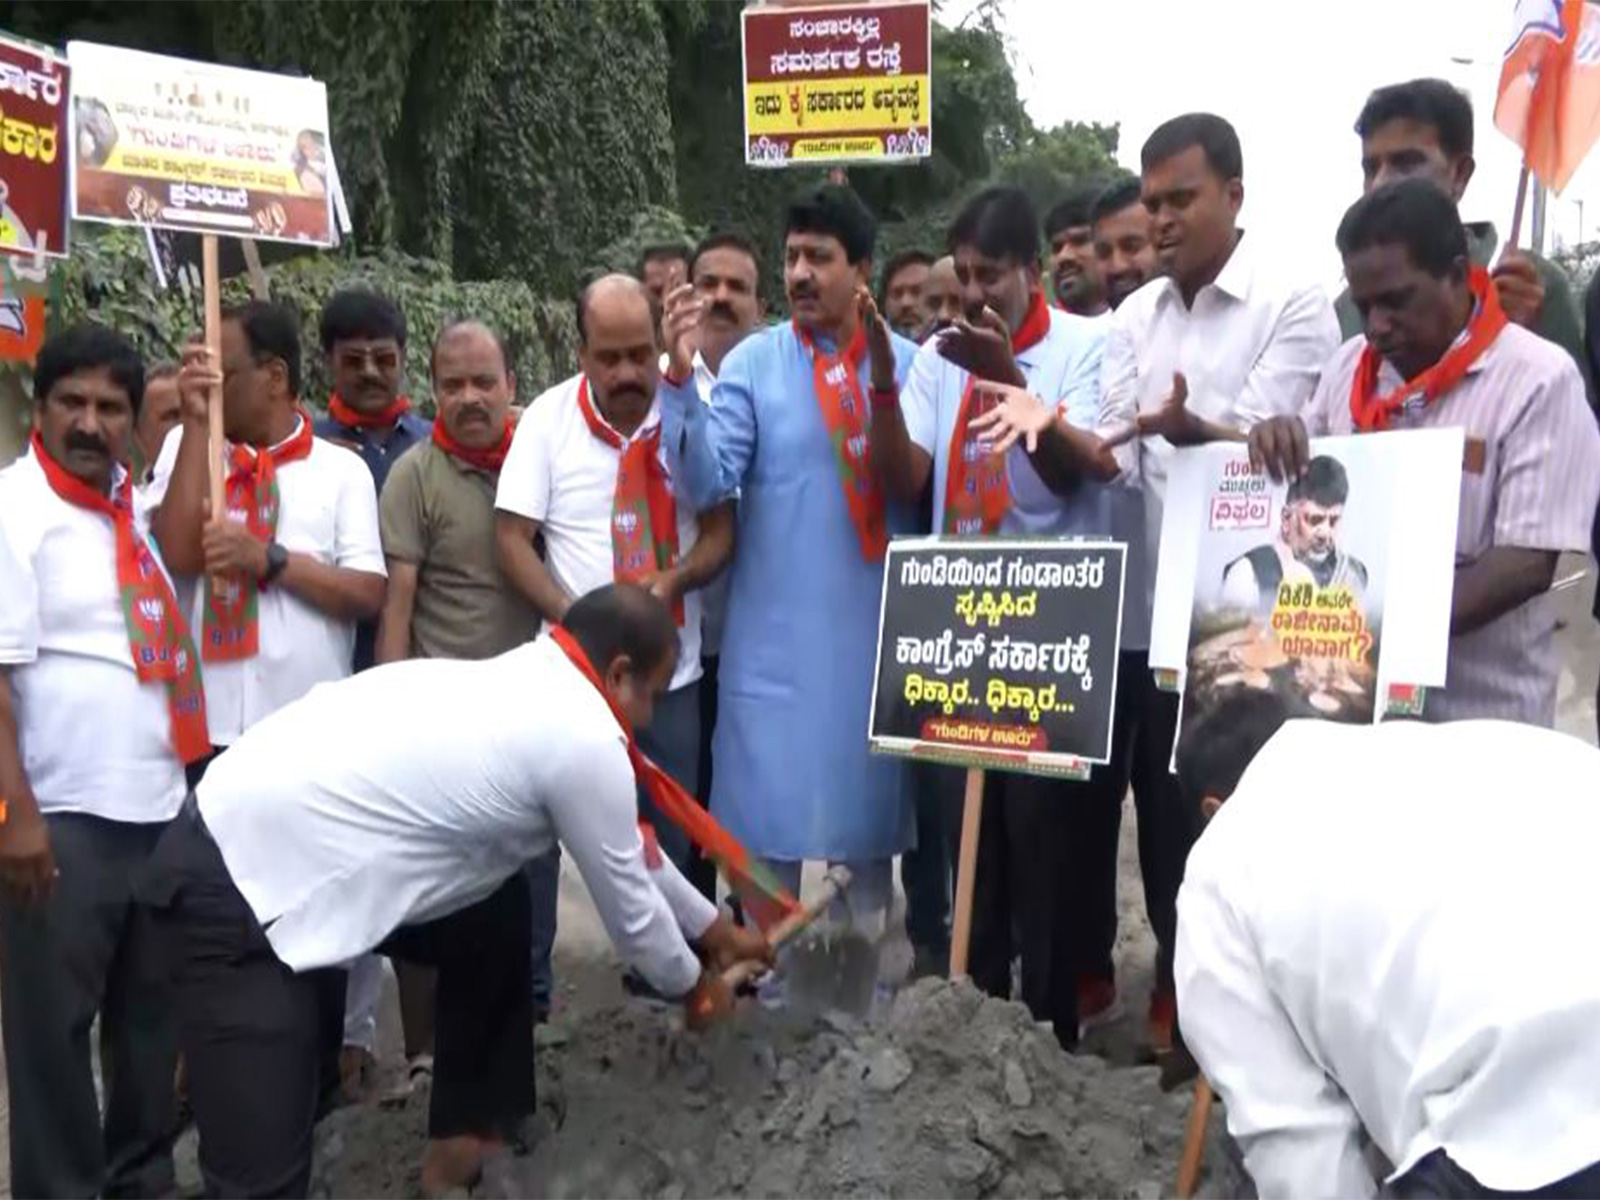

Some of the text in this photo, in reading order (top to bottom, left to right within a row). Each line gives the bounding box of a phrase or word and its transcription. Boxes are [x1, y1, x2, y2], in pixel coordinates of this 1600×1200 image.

[770, 42, 902, 75] ಸಮರ್ಪಕ ರಸ್ತೆ
[0, 61, 62, 105] ರ್ಕಾರ
[754, 92, 781, 116] ಇದು
[806, 86, 866, 113] ಸರ್ಕಾರದ
[1215, 500, 1266, 526] ವಿಫಲ
[900, 555, 1105, 589] ಗುಂಡಿಯಿಂದ ಗಂಡಾಂತರ
[954, 591, 1037, 627] ಸೃಷ್ಟಿಸಿದ
[895, 629, 1093, 692] ಕಾಂಗ್ರೆಸ್ ಸರ್ಕಾರಕ್ಕೆ
[903, 672, 1076, 722] ಧಿಕ್ಕಾರ.. ಧಿಕ್ಕಾರ...
